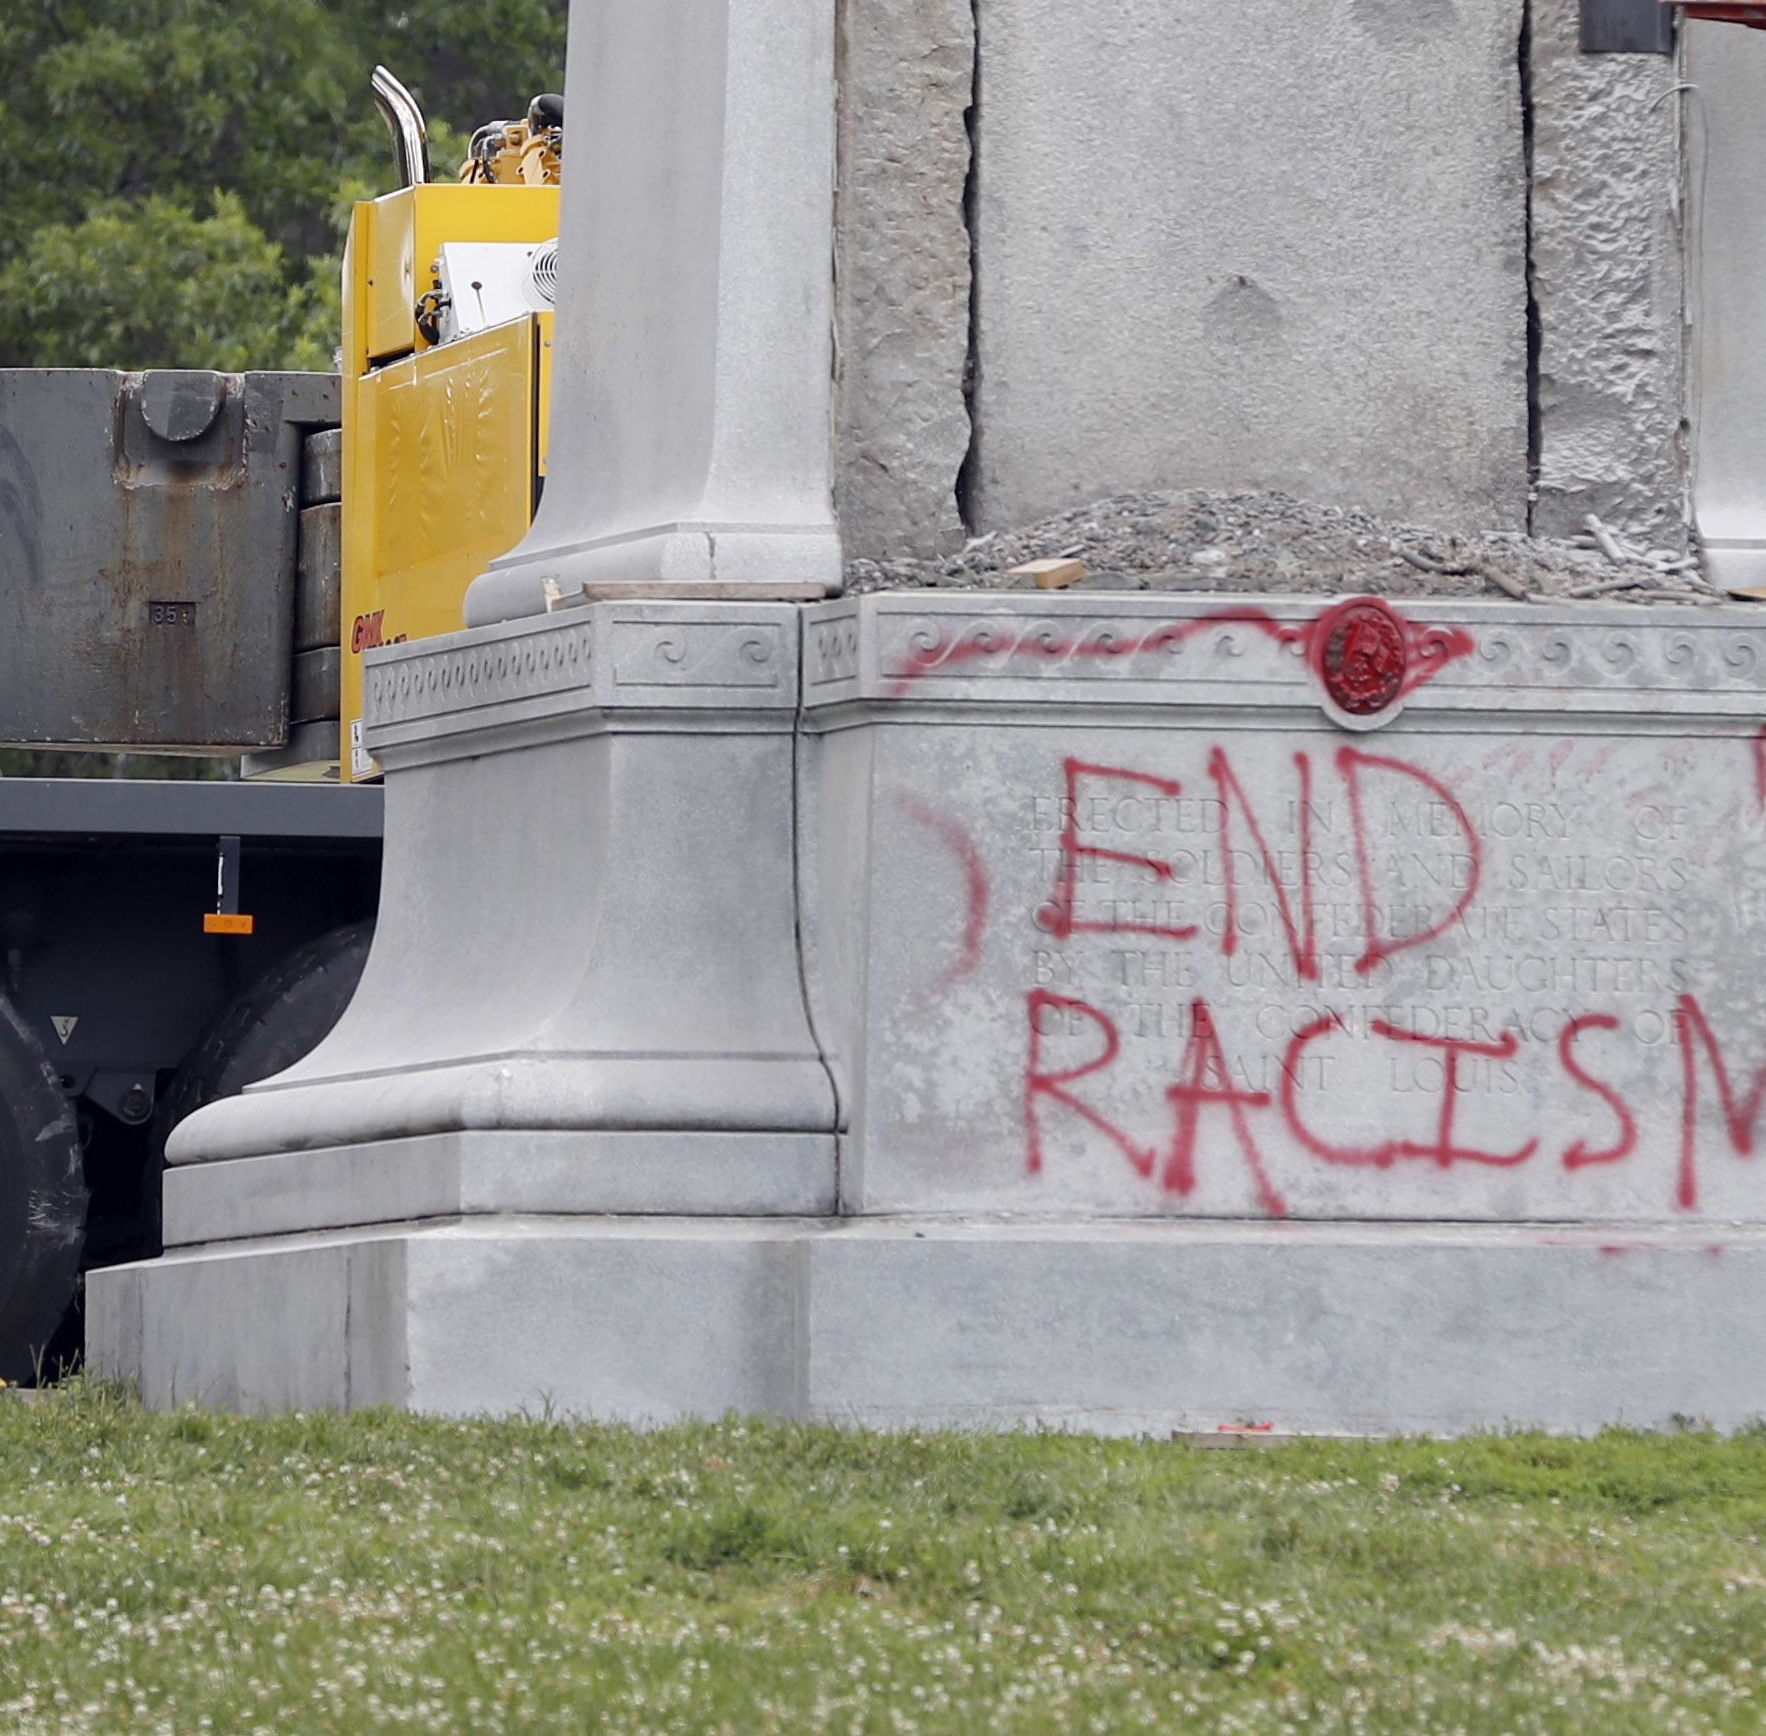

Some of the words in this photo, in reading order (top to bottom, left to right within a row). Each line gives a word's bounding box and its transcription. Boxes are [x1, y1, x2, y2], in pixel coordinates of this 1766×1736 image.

[1031, 795, 1230, 834] ERECTED
[1288, 799, 1334, 835] IN
[1388, 800, 1580, 841] MEMORY
[1634, 804, 1689, 841] OF
[1028, 846, 1110, 885] THE
[1143, 847, 1354, 888] SOLDIERS
[1386, 851, 1480, 891] AND
[1507, 854, 1690, 893] SAILORS
[1040, 744, 1482, 981] END
[1098, 899, 1187, 936] THE
[1539, 906, 1689, 943] STATES
[1032, 950, 1086, 987] BY
[1110, 951, 1195, 988] THE
[1225, 951, 1395, 991] UNITED
[1424, 954, 1690, 994] DAUGHTERS
[1129, 1002, 1214, 1039] THE
[1256, 1004, 1588, 1043] CONFEDERACY
[1202, 1055, 1337, 1093] SAINT
